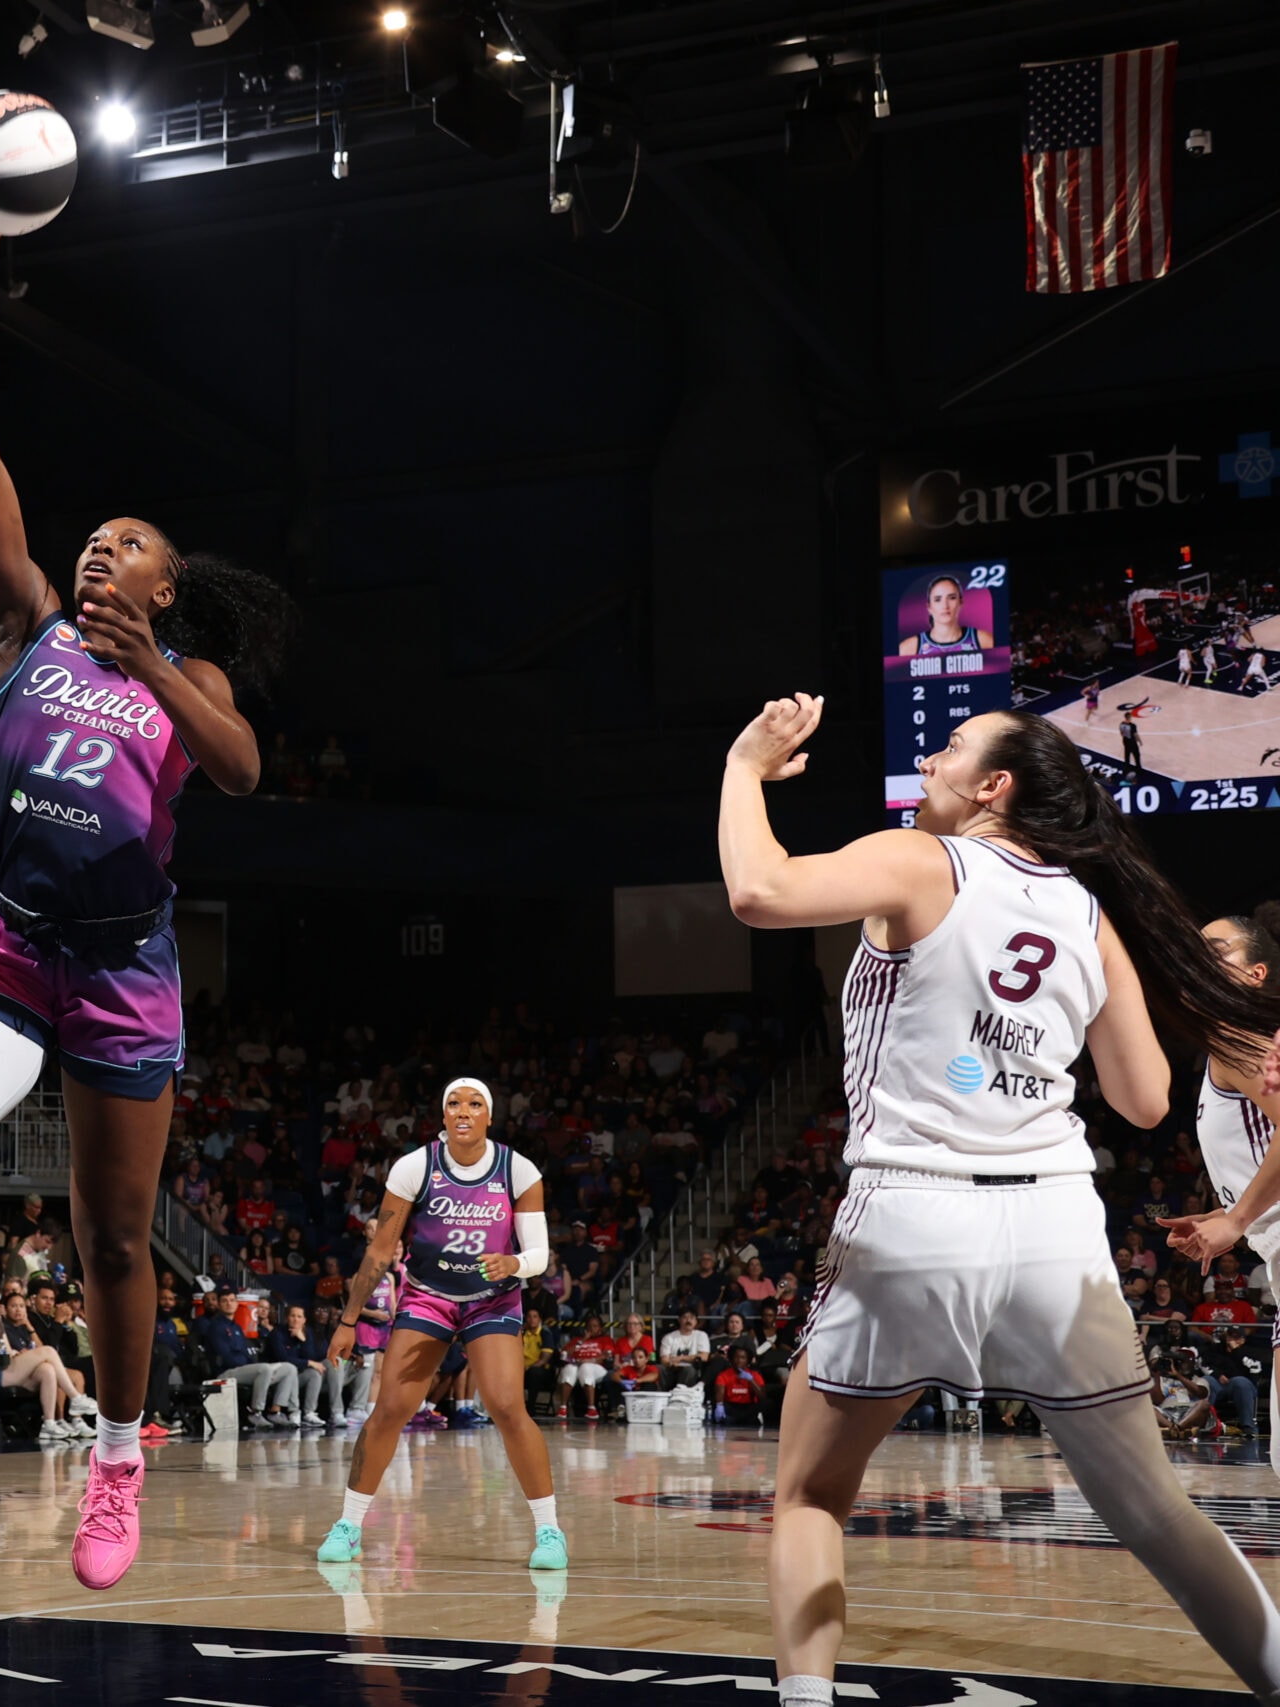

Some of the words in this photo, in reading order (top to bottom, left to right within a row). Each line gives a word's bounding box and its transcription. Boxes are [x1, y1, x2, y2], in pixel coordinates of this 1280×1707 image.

[908, 443, 1200, 529] CareFirst
[966, 564, 1007, 591] 22
[910, 657, 942, 677] SONIA
[946, 653, 983, 674] CITRON
[23, 664, 160, 739] District
[912, 685, 926, 701] 2
[949, 683, 971, 695] PTS
[41, 702, 65, 718] OF
[63, 709, 133, 739] CHANGE
[913, 709, 926, 725] 0
[949, 706, 971, 718] RBS
[915, 731, 926, 747] 1
[29, 728, 116, 789] 12
[1215, 779, 1233, 789] 1st
[1113, 785, 1160, 814] 10
[1190, 785, 1259, 811] 2:25
[29, 796, 102, 830] VANDA
[901, 810, 916, 829] 5
[401, 923, 444, 957] 109
[987, 930, 1058, 1004] 3
[970, 1009, 1046, 1060] MABREY
[988, 1070, 1056, 1101] AT&T
[427, 1196, 506, 1221] District
[455, 1218, 493, 1226] CHANGE
[441, 1229, 487, 1256] 23
